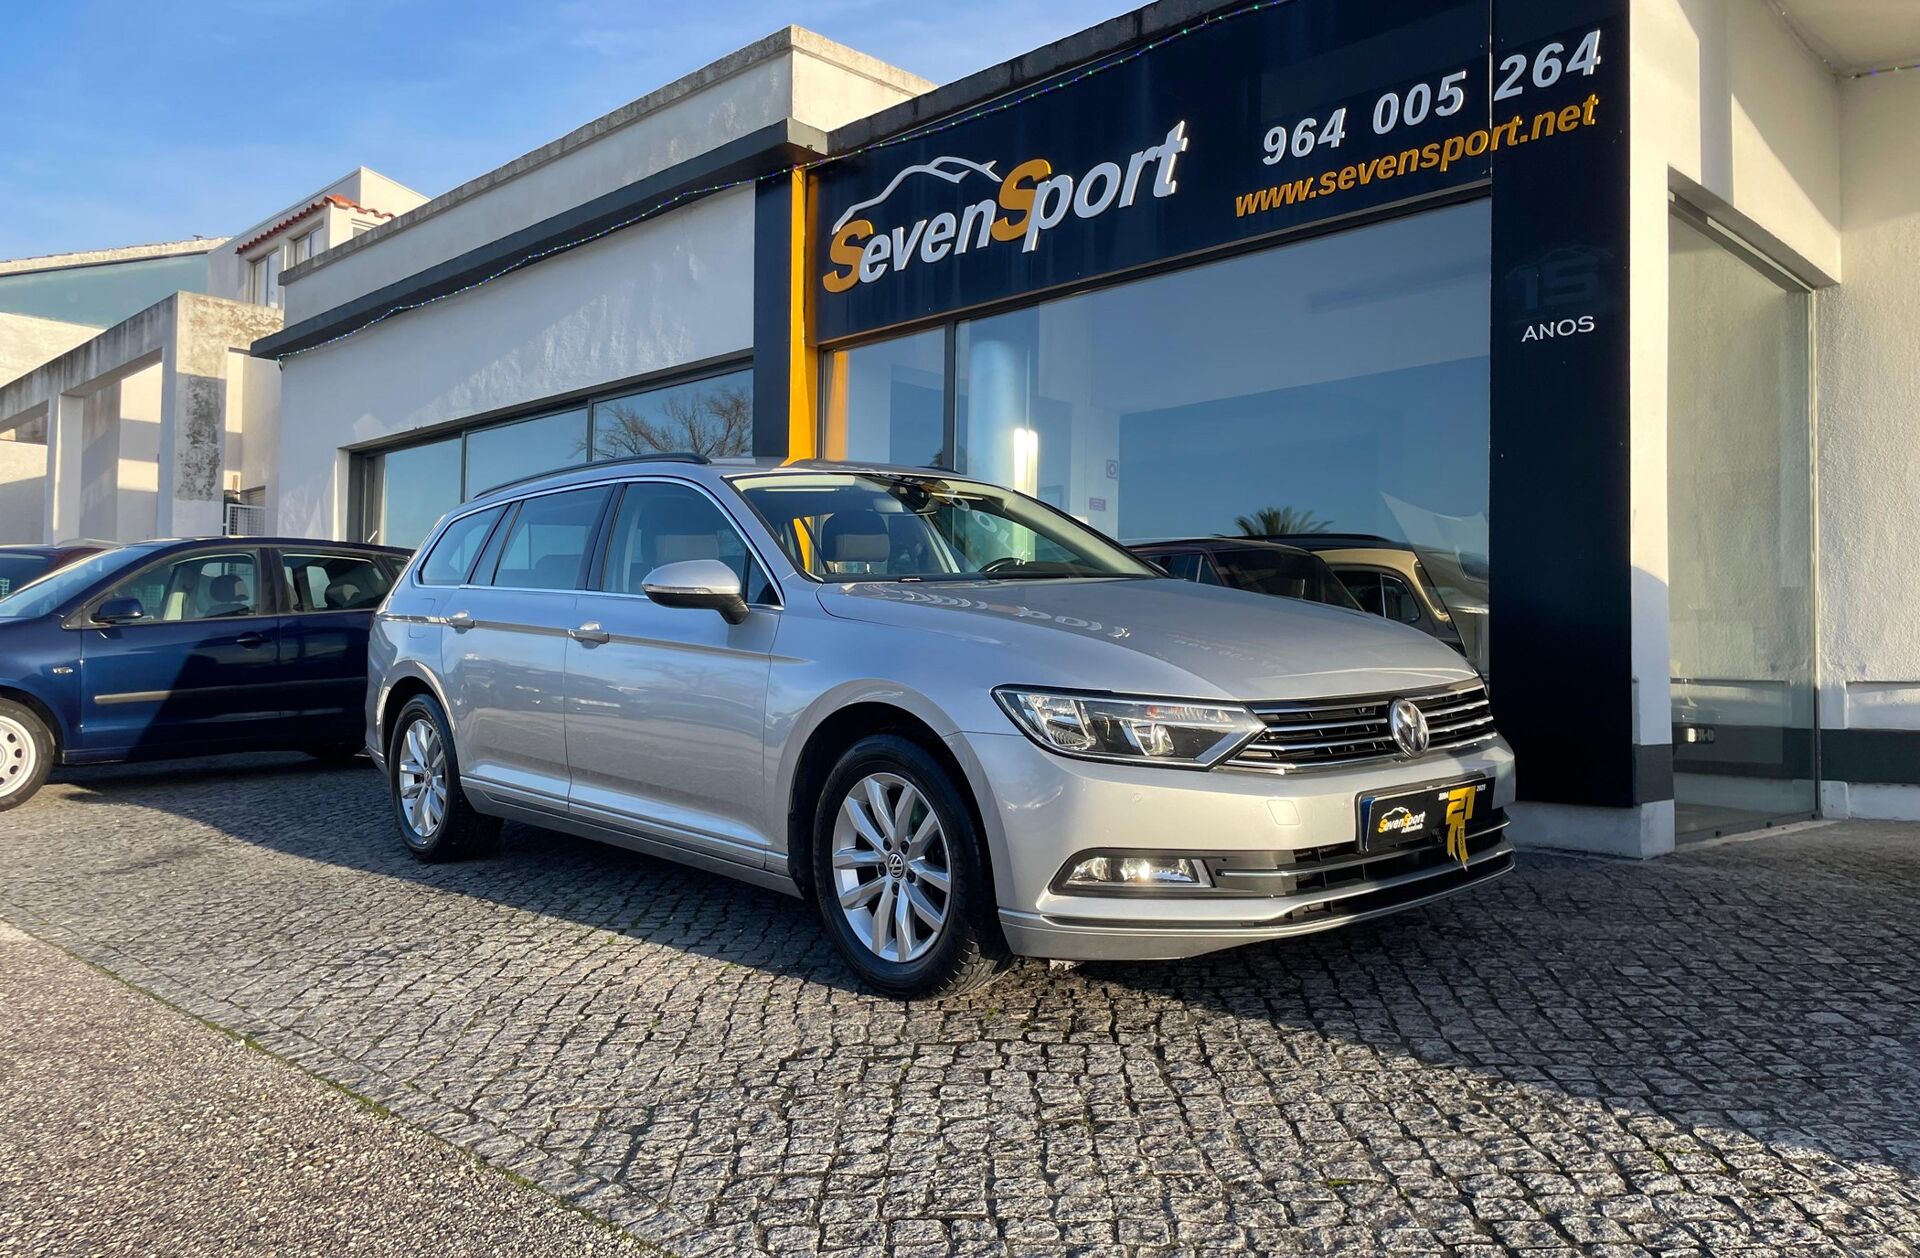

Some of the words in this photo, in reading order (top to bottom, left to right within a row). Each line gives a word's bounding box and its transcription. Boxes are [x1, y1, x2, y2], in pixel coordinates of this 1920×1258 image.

[1235, 94, 1600, 219] www.sevensport.net
[1262, 107, 1346, 167] 964
[1372, 70, 1467, 136] 005
[1493, 28, 1602, 102] 264
[822, 120, 1189, 293] SevenSport
[1521, 315, 1596, 343] ANOS
